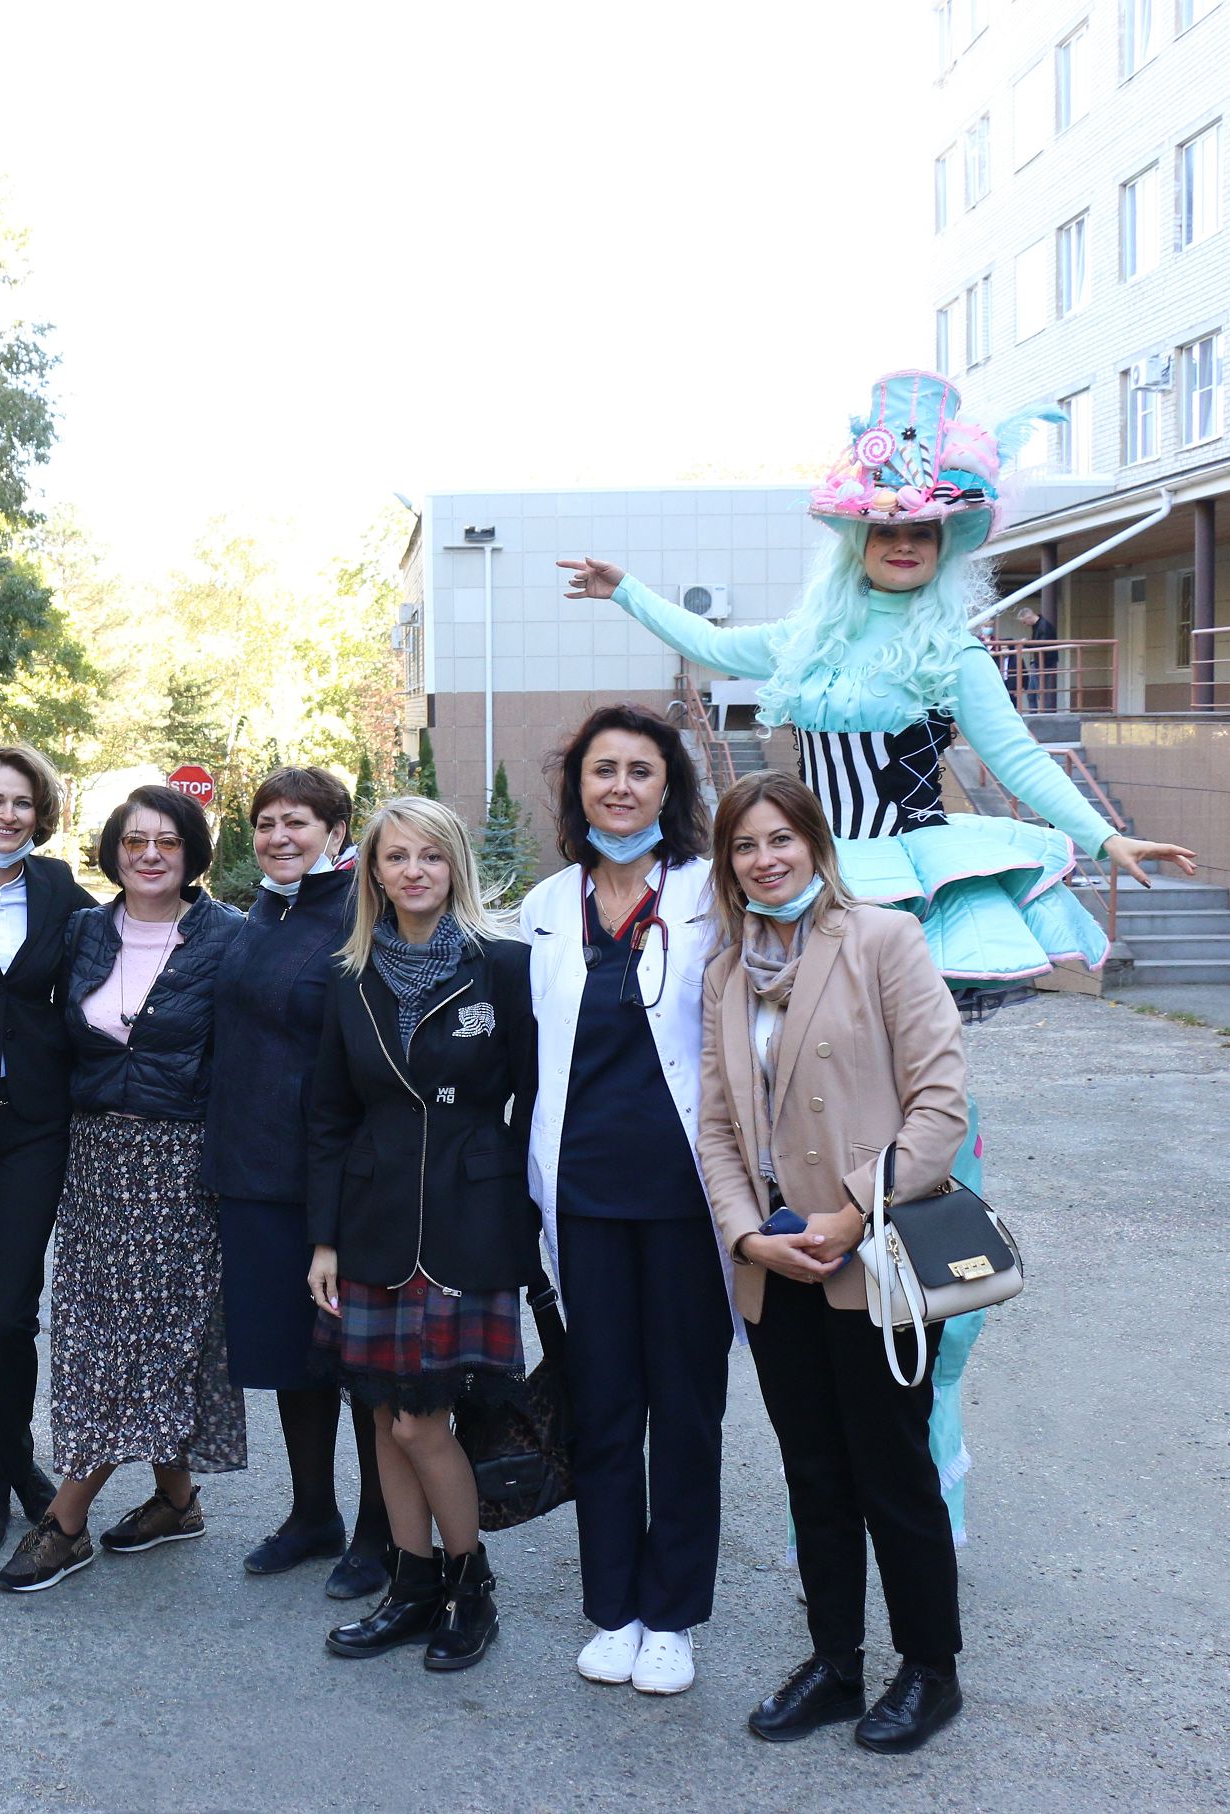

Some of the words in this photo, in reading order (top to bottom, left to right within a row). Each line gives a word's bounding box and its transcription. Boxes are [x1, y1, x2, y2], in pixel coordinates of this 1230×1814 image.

[170, 781, 212, 795] STOP
[438, 1087, 455, 1095] wa
[436, 1095, 455, 1103] ng
